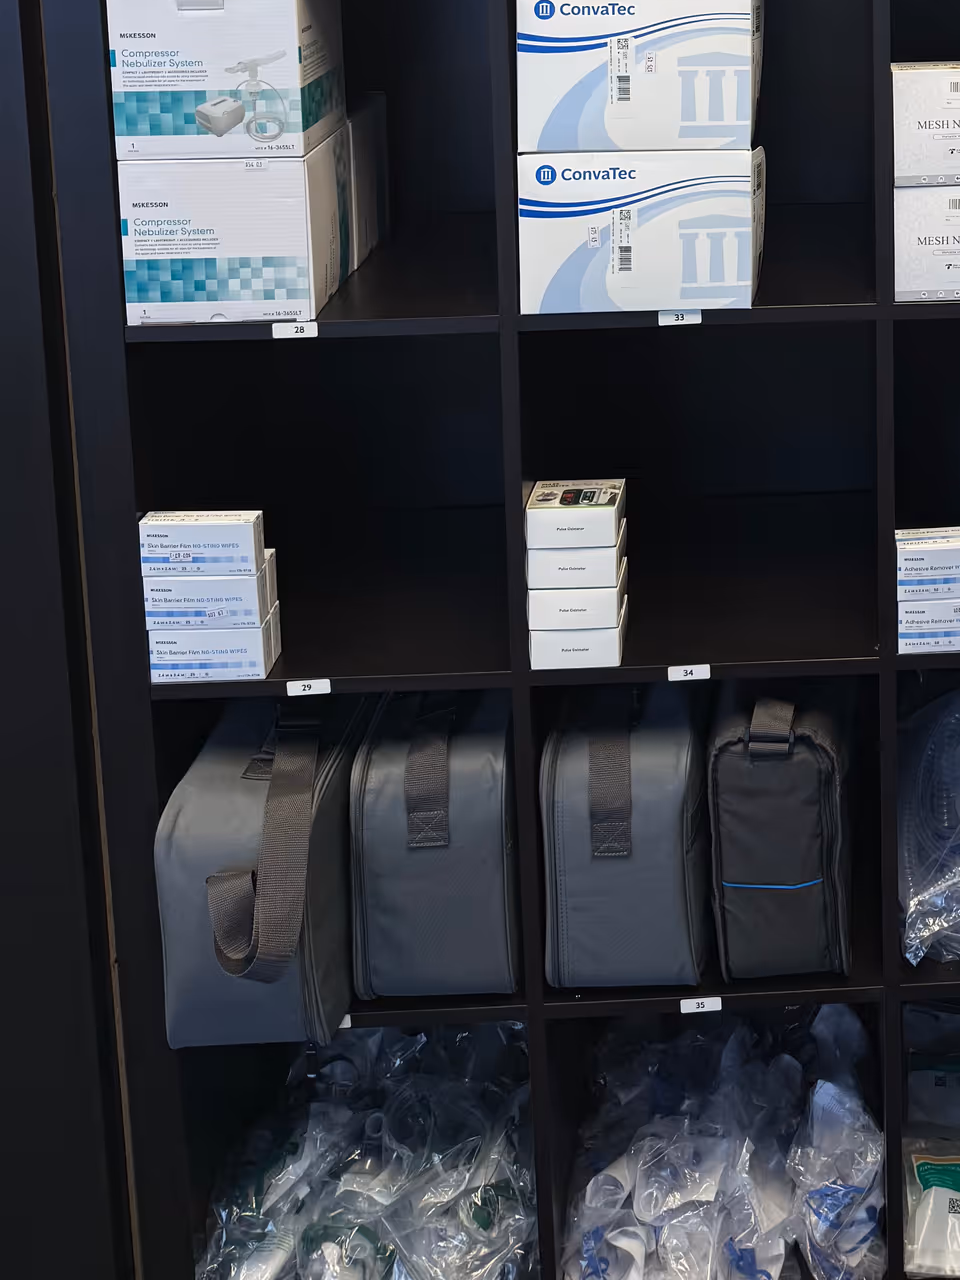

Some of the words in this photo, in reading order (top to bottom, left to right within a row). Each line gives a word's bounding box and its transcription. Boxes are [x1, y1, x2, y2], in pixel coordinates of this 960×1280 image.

[560, 3, 635, 16] ConvaTec
[121, 49, 179, 60] Compressor
[122, 58, 166, 68] Nebulizer
[169, 59, 203, 69] System
[918, 120, 949, 129] MESH
[561, 167, 636, 181] ConvaTec
[133, 218, 191, 228] Compressor
[134, 228, 178, 236] Nebulizer
[181, 227, 214, 237] System
[918, 236, 949, 245] MESH
[674, 313, 684, 322] 33
[683, 669, 694, 677] 34
[695, 1001, 706, 1010] 35
